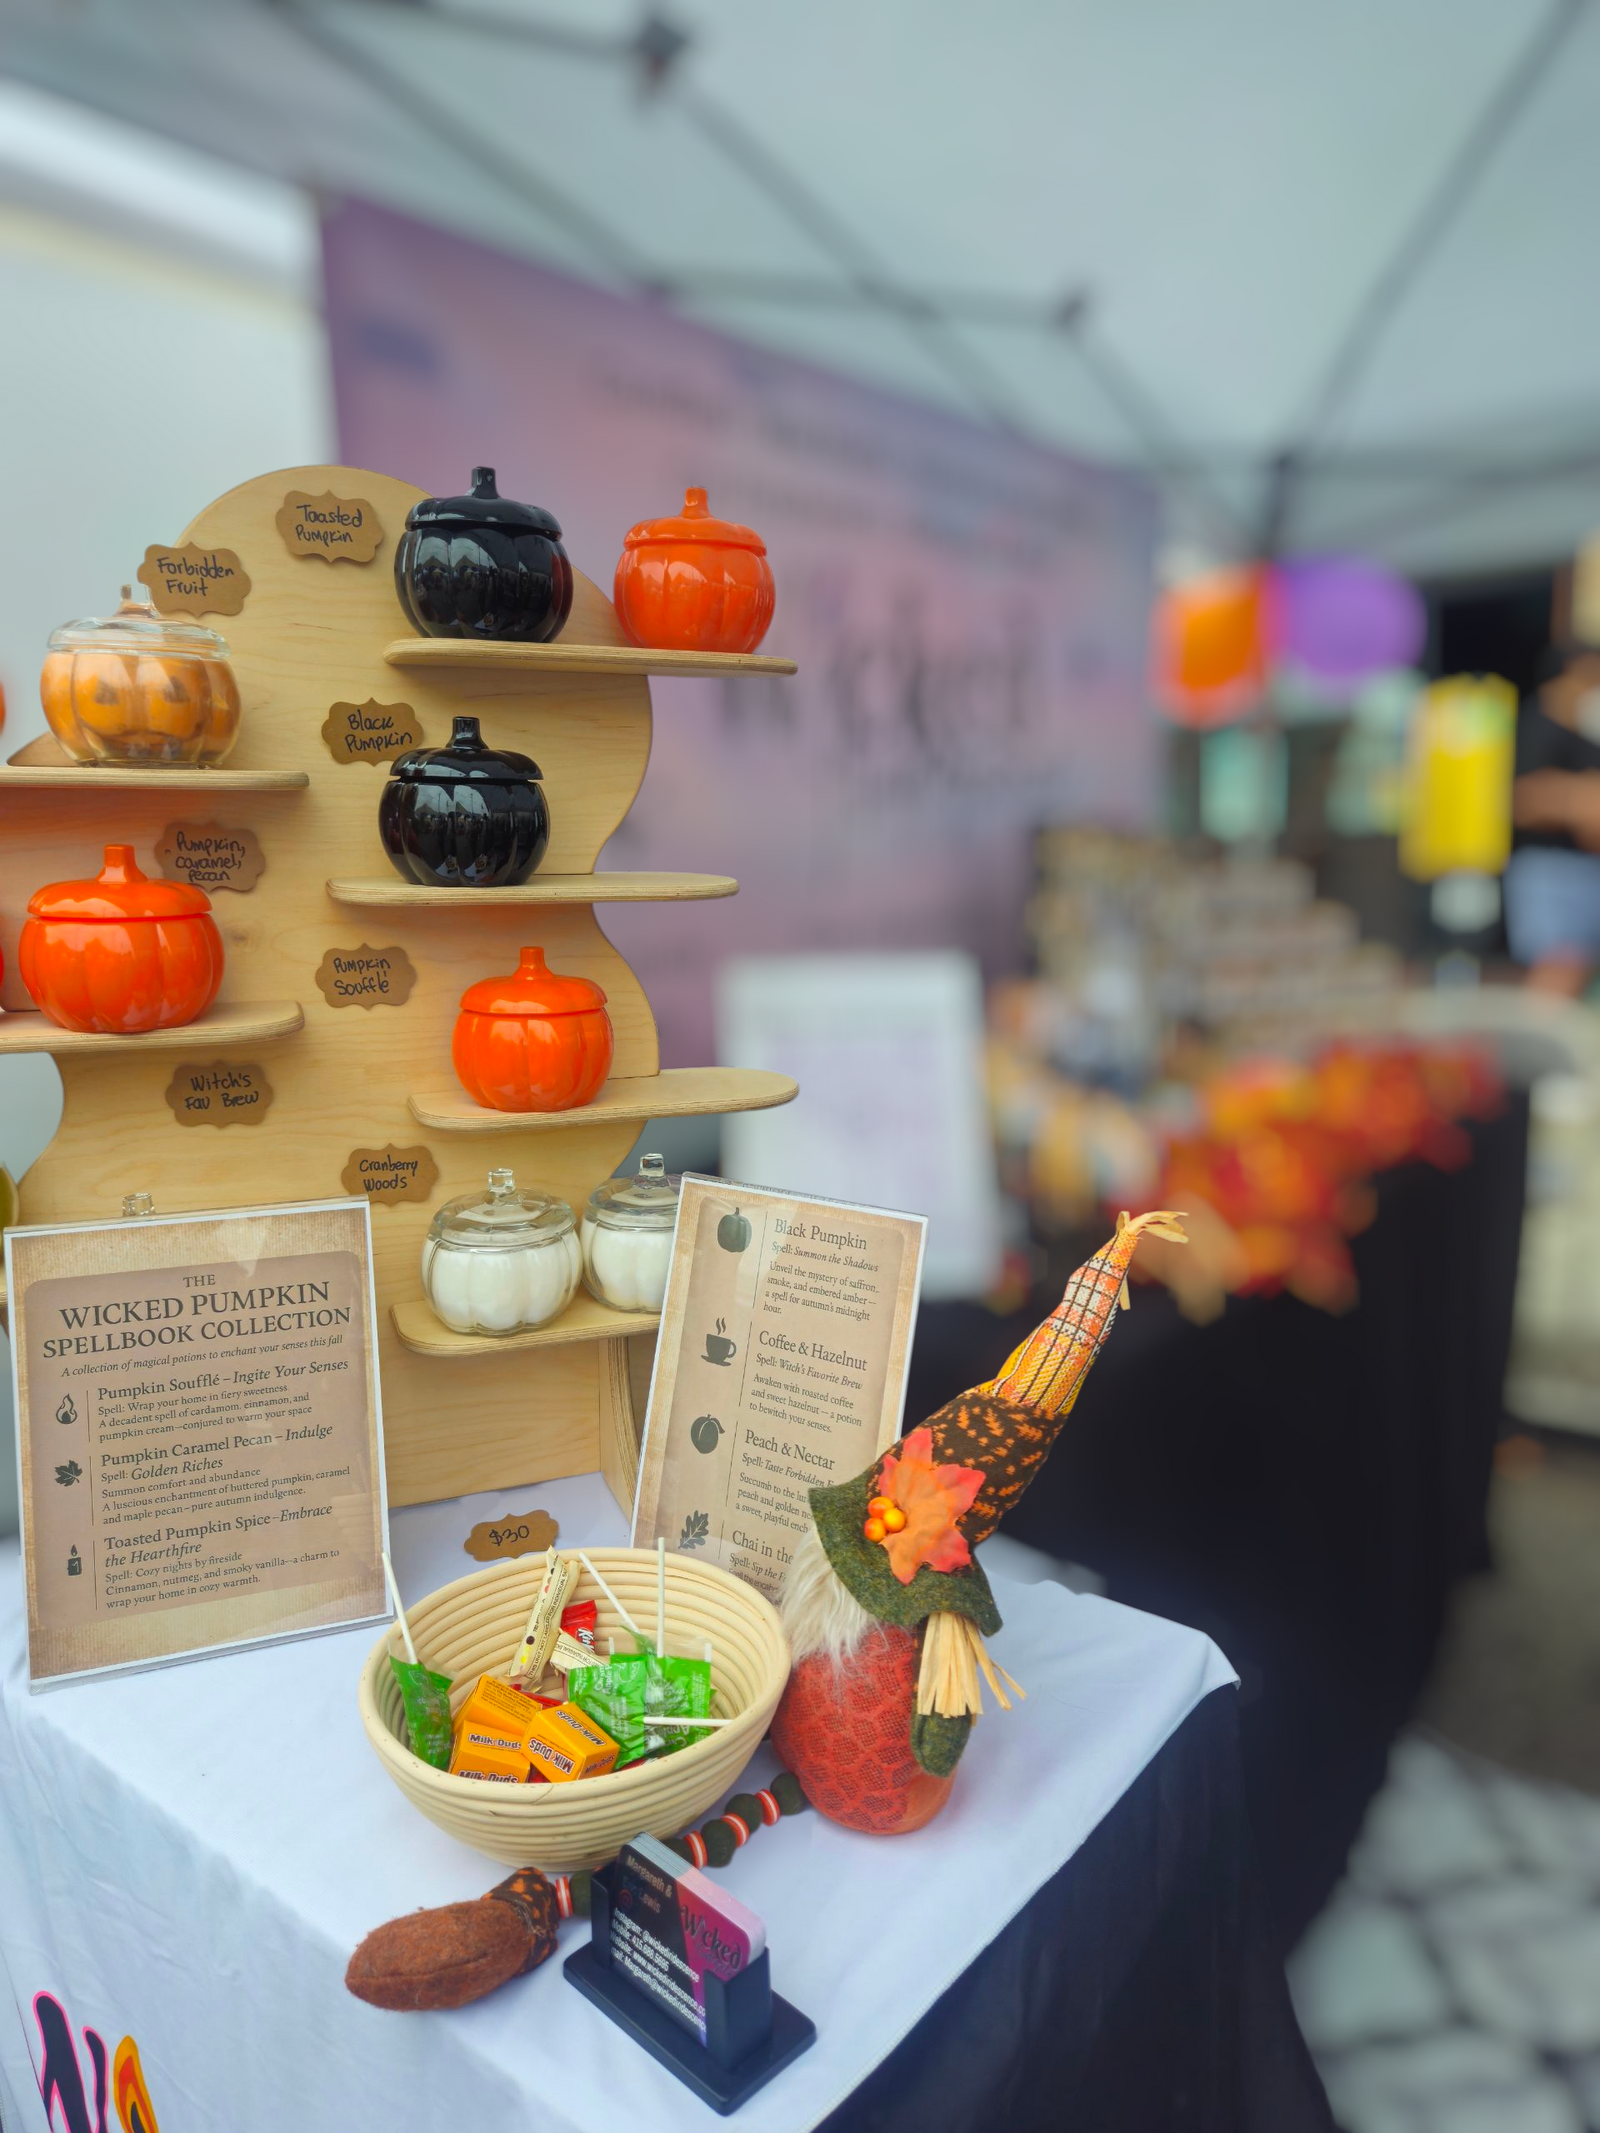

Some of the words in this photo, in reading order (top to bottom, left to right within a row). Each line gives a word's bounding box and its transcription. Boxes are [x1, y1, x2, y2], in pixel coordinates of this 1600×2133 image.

[296, 505, 363, 527] Toasted
[157, 554, 234, 578] Forbidden
[166, 579, 208, 596] Fruit
[348, 709, 394, 730] Black
[360, 1154, 418, 1176] Cranberry
[363, 1173, 408, 1192] Woods
[774, 1218, 805, 1238] Black
[810, 1225, 866, 1249] Pumpkin
[183, 1274, 215, 1287] THE
[59, 1298, 183, 1328] WICKED
[190, 1281, 329, 1315] PUMPKIN
[43, 1325, 194, 1357] SPELLBOOK
[201, 1307, 350, 1339] COLLECTION
[61, 1368, 69, 1376] A
[72, 1364, 117, 1374] collection
[121, 1359, 132, 1371] of
[134, 1355, 169, 1368] magical
[172, 1353, 206, 1365] potions
[220, 1347, 255, 1357] enchant
[282, 1341, 307, 1350] senses
[310, 1337, 325, 1346] this
[327, 1334, 342, 1346] fall
[759, 1330, 795, 1352] Coffee
[798, 1342, 808, 1355] &
[811, 1343, 867, 1370] Hazelnut
[98, 1382, 164, 1400] Pumpkin
[170, 1374, 219, 1390] Soufflé
[233, 1369, 270, 1384] Ingite
[274, 1365, 306, 1377] Your
[309, 1361, 348, 1373] Senses
[98, 1404, 124, 1416] Spell:
[128, 1402, 154, 1410] Wrap
[157, 1399, 178, 1409] your
[181, 1396, 206, 1404] home
[244, 1385, 287, 1395] sweetness
[109, 1415, 152, 1426] decadent
[155, 1409, 175, 1422] spell
[178, 1408, 188, 1416] of
[293, 1392, 308, 1401] and
[99, 1429, 143, 1443] pumpkin
[265, 1410, 285, 1420] your
[288, 1407, 311, 1416] space
[101, 1448, 168, 1466] Pumpkin
[172, 1437, 229, 1456] Caramel
[233, 1435, 271, 1447] Pecan
[285, 1424, 332, 1440] Indulge
[745, 1429, 777, 1452] Peach
[781, 1442, 791, 1456] &
[793, 1444, 834, 1470] Nectar
[101, 1470, 127, 1483] Spell:
[131, 1464, 177, 1479] Golden
[182, 1457, 222, 1472] Riches
[102, 1486, 145, 1498] Summon
[148, 1479, 185, 1491] comfort
[189, 1474, 205, 1484] and
[209, 1469, 260, 1481] abundance
[102, 1503, 110, 1511] A
[113, 1499, 152, 1509] luscious
[155, 1488, 216, 1502] enchantment
[218, 1484, 228, 1493] of
[231, 1478, 268, 1491] buttered
[316, 1466, 349, 1478] caramel
[103, 1513, 120, 1524] and
[124, 1509, 152, 1520] maple
[215, 1496, 250, 1506] autumn
[104, 1529, 161, 1549] Toasted
[166, 1520, 230, 1540] Pumpkin
[235, 1515, 270, 1531] Spice
[489, 1526, 529, 1546] $30
[732, 1530, 758, 1551] Chai
[761, 1541, 772, 1557] in
[106, 1554, 125, 1567] the
[130, 1542, 201, 1563] Hearthfire
[204, 1568, 220, 1578] and
[300, 1552, 327, 1561] charm
[106, 1570, 132, 1583] Spell:
[163, 1561, 191, 1572] nights
[195, 1558, 206, 1568] by
[106, 1599, 131, 1608] wrap
[134, 1595, 155, 1606] your
[159, 1590, 184, 1599] home
[468, 1734, 494, 1744] Milk
[528, 1738, 553, 1762] Duds
[554, 1752, 576, 1774] Milk
